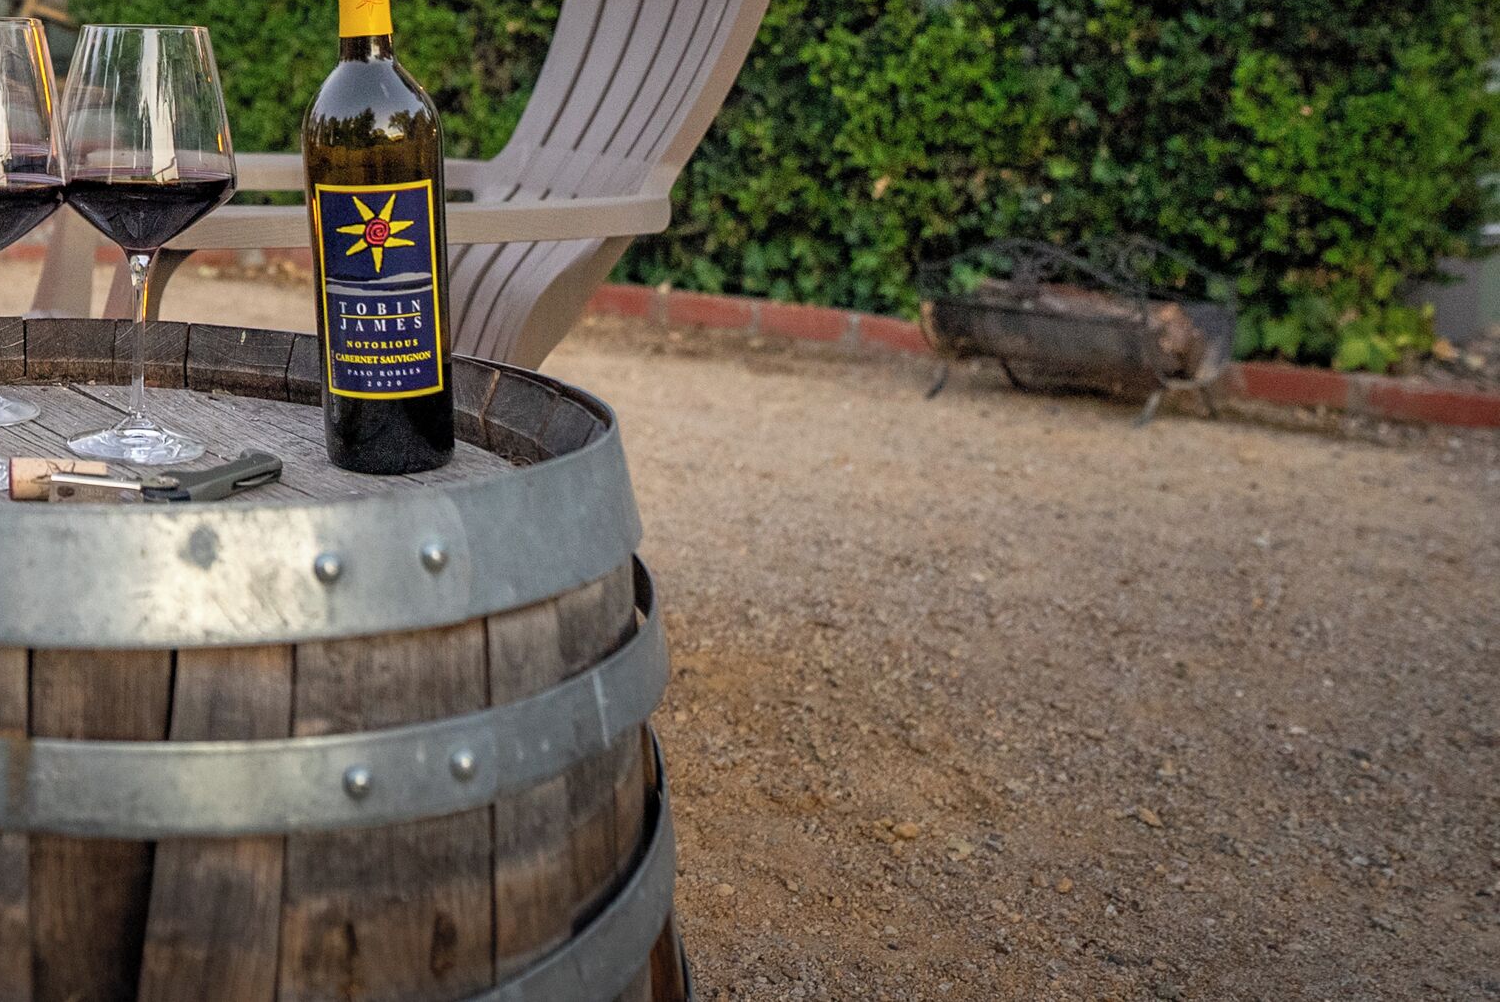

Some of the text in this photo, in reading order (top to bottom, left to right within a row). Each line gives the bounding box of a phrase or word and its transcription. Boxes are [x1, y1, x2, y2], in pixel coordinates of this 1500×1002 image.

[339, 300, 420, 315] TOBIN
[340, 316, 422, 332] JAMES
[346, 339, 418, 348] NOTORIOUS
[335, 350, 431, 364] CABERNET SAUVIGNON
[347, 367, 421, 377] PASO ROBLES
